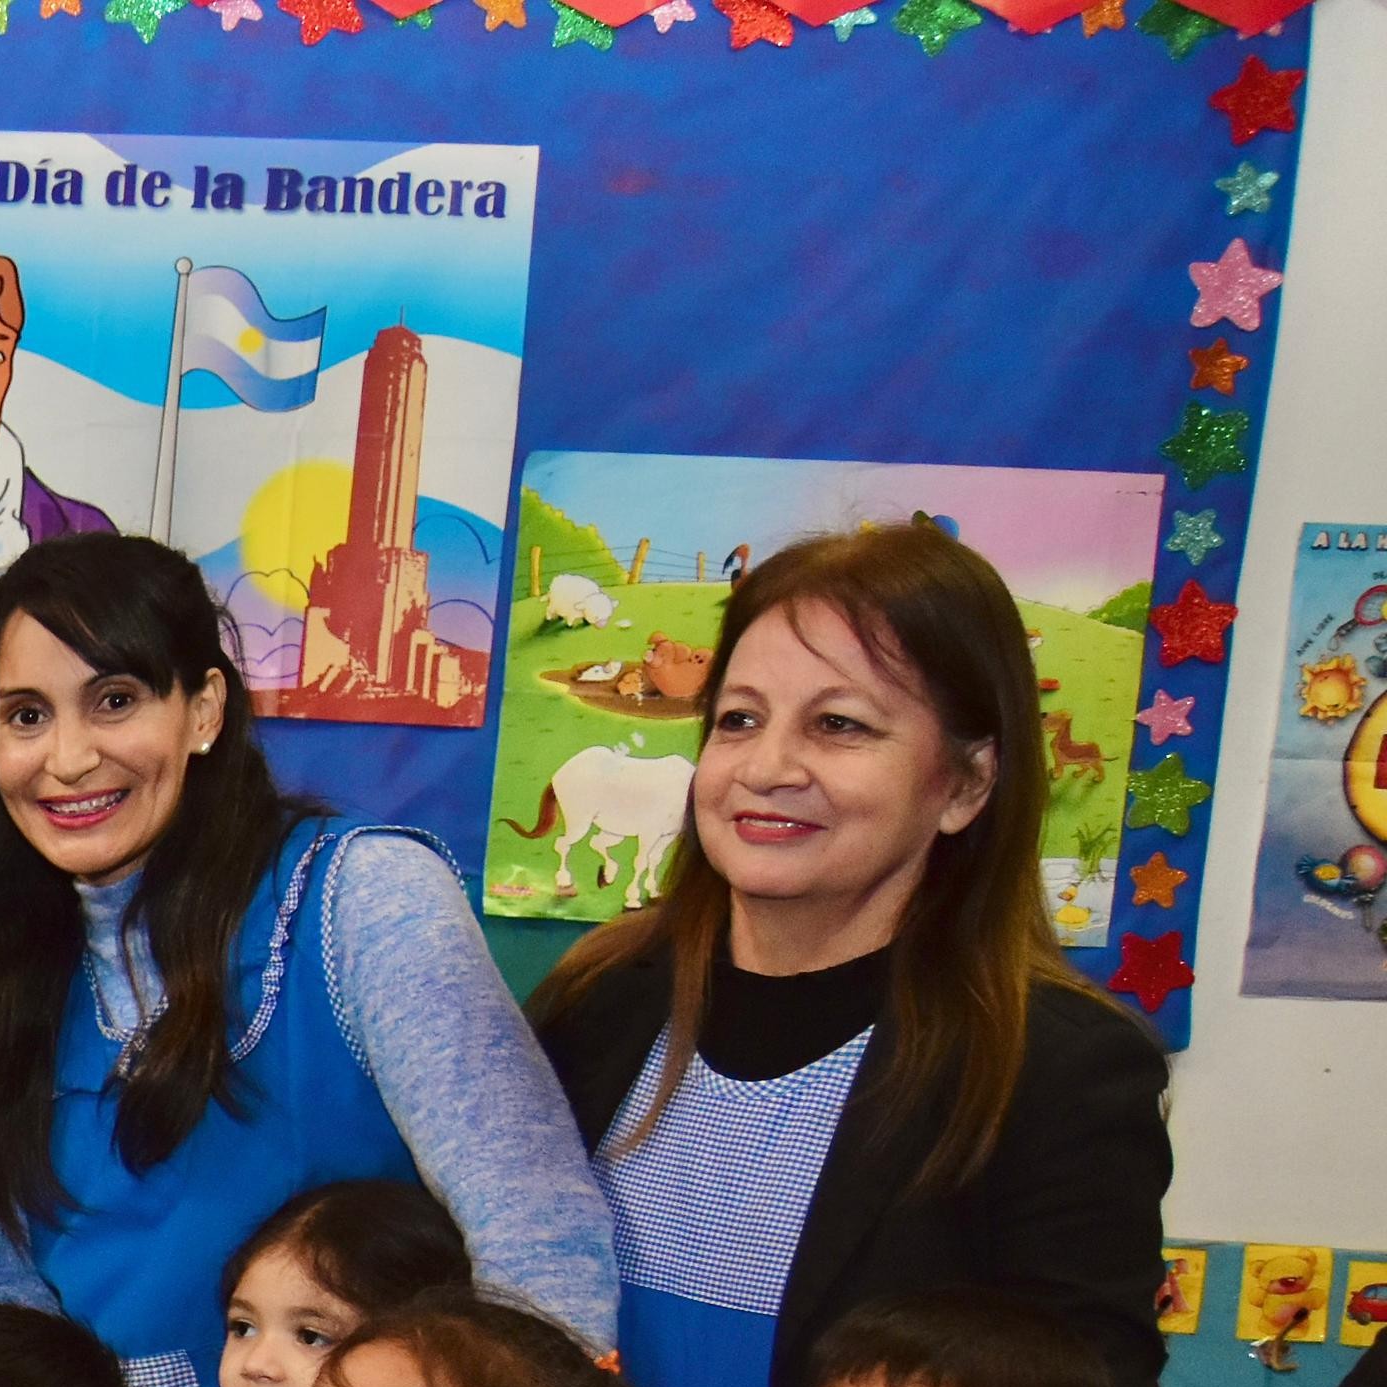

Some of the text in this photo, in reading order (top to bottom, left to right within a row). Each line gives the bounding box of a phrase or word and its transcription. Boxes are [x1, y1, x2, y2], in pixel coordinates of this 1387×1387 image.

[104, 163, 171, 209] de
[191, 165, 245, 211] la
[263, 166, 507, 220] Bandera
